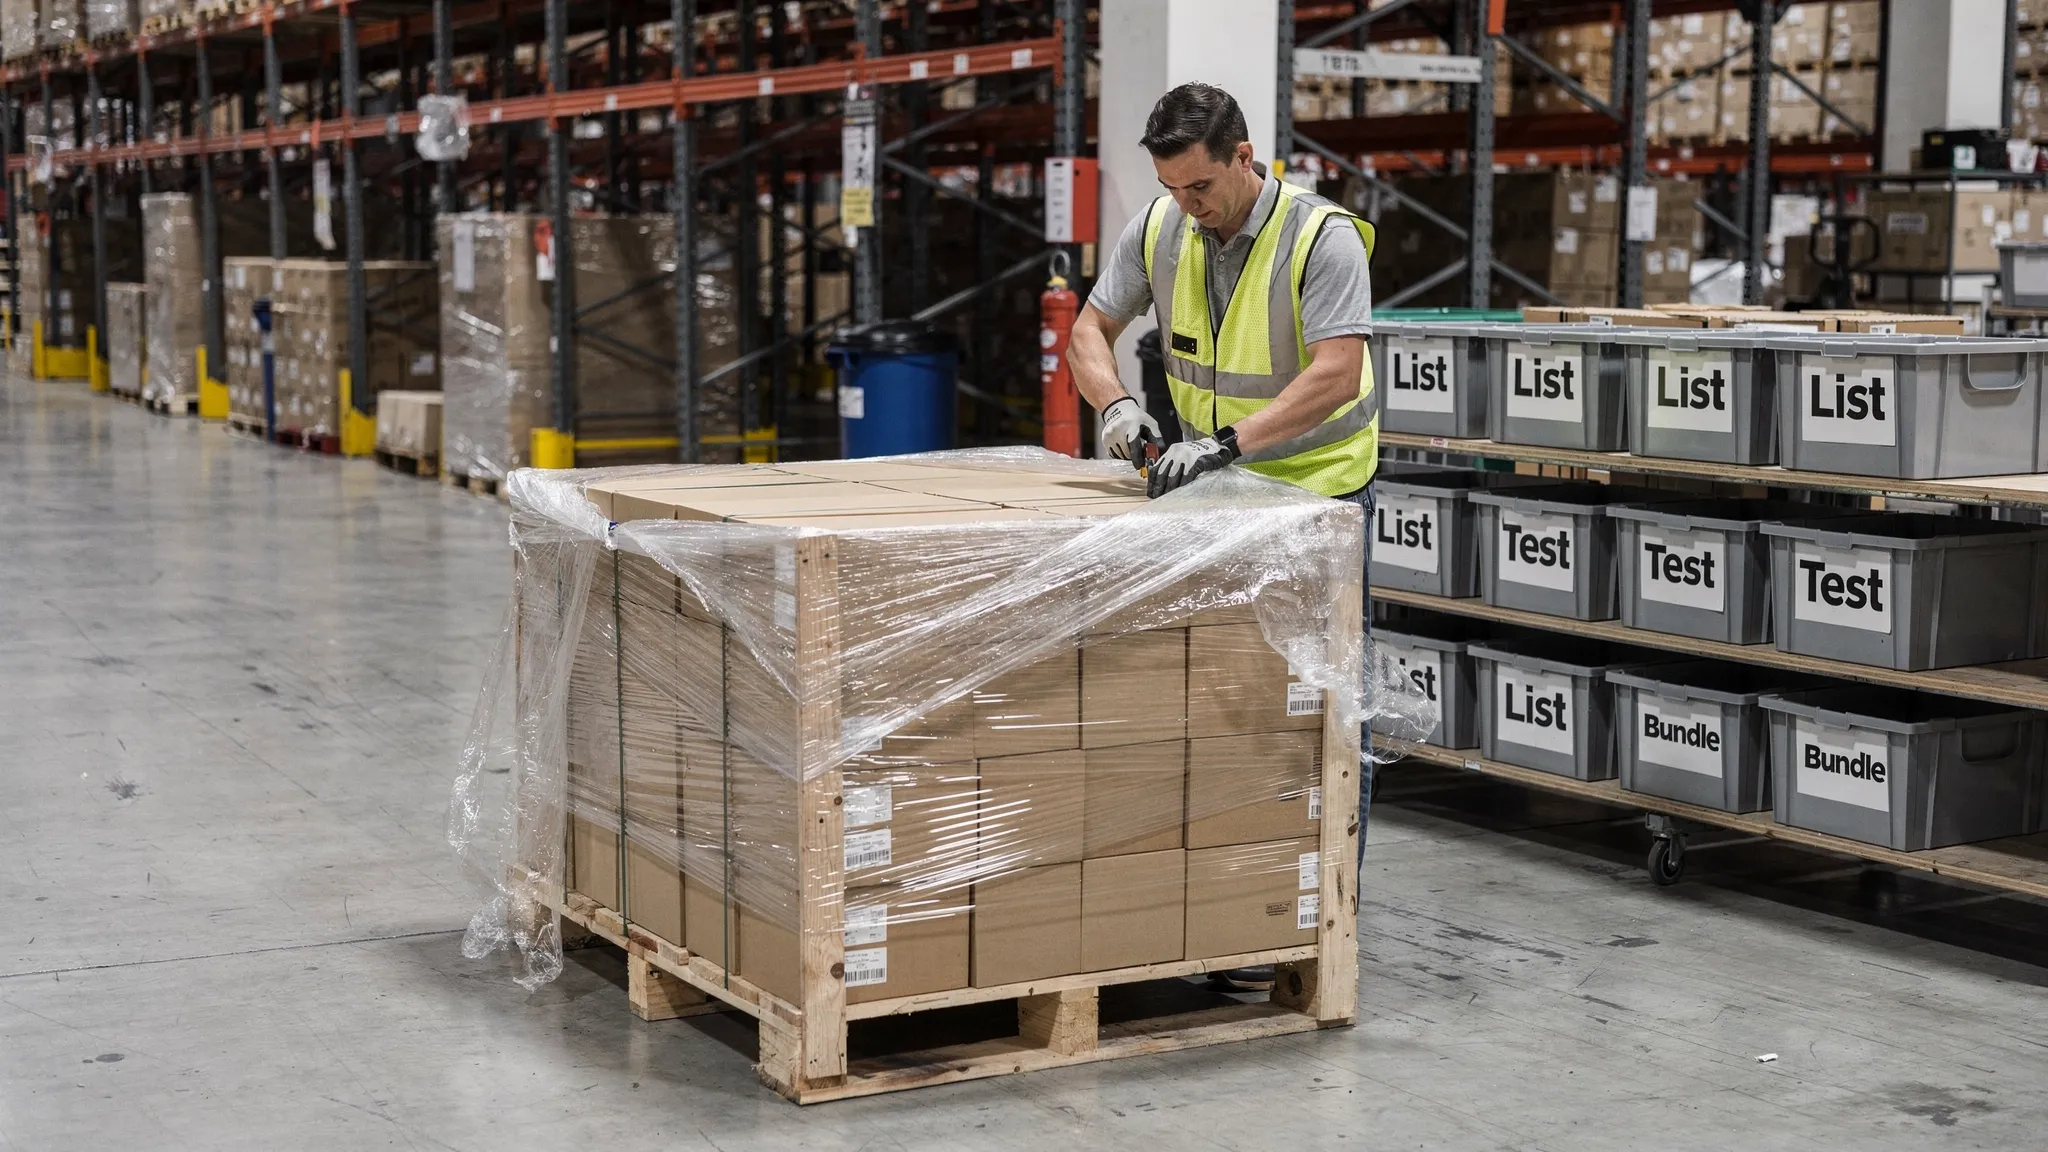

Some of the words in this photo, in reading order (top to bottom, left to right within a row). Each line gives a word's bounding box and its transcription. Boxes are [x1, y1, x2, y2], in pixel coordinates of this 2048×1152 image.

[1394, 352, 1448, 392] List
[1514, 357, 1575, 400] List
[1657, 366, 1726, 411] List
[1811, 373, 1886, 421] List
[1378, 507, 1432, 551] List
[1502, 523, 1570, 570] Test
[1644, 542, 1715, 589] Test
[1799, 558, 1884, 613] Test
[1505, 682, 1567, 732] List
[1643, 713, 1721, 752] Bundle
[1804, 743, 1886, 784] Bundle
